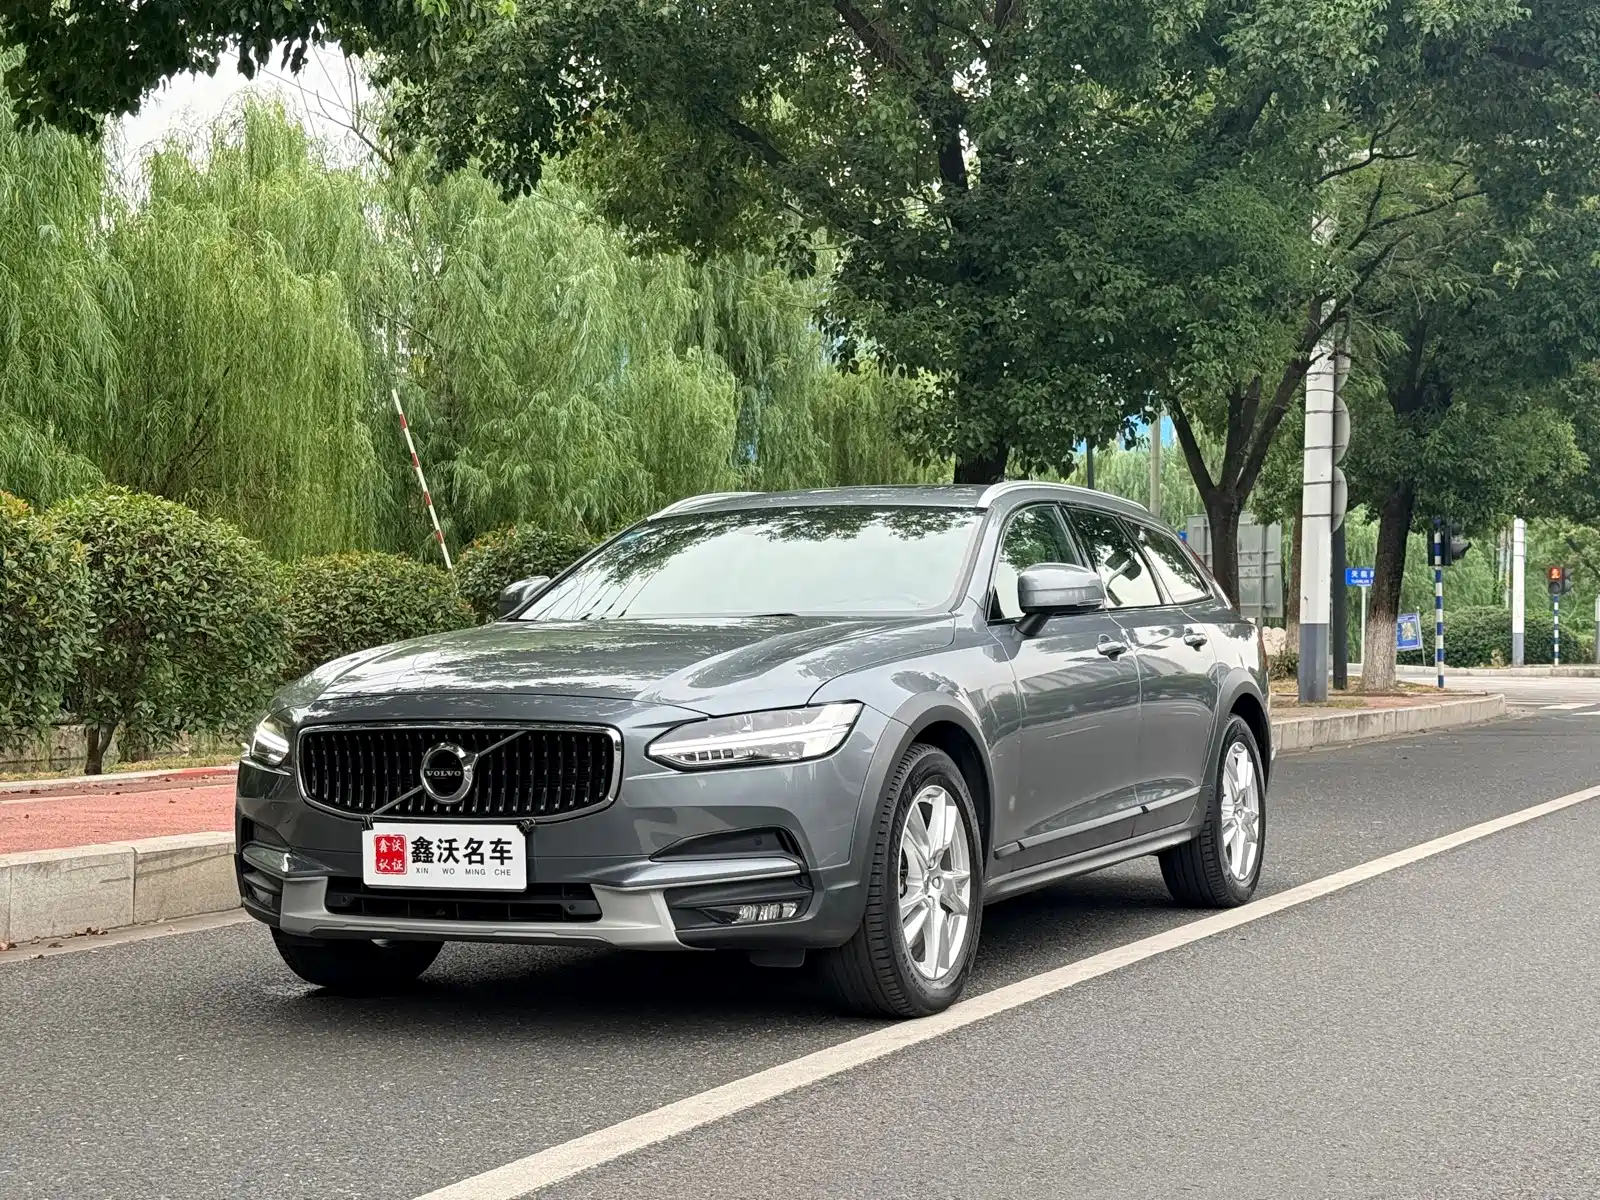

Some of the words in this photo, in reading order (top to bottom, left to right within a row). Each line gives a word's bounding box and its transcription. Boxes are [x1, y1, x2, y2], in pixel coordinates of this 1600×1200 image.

[410, 836, 513, 866] 鑫沃名车
[441, 867, 455, 875] WO
[464, 868, 486, 876] MING
[494, 868, 511, 876] CHE
